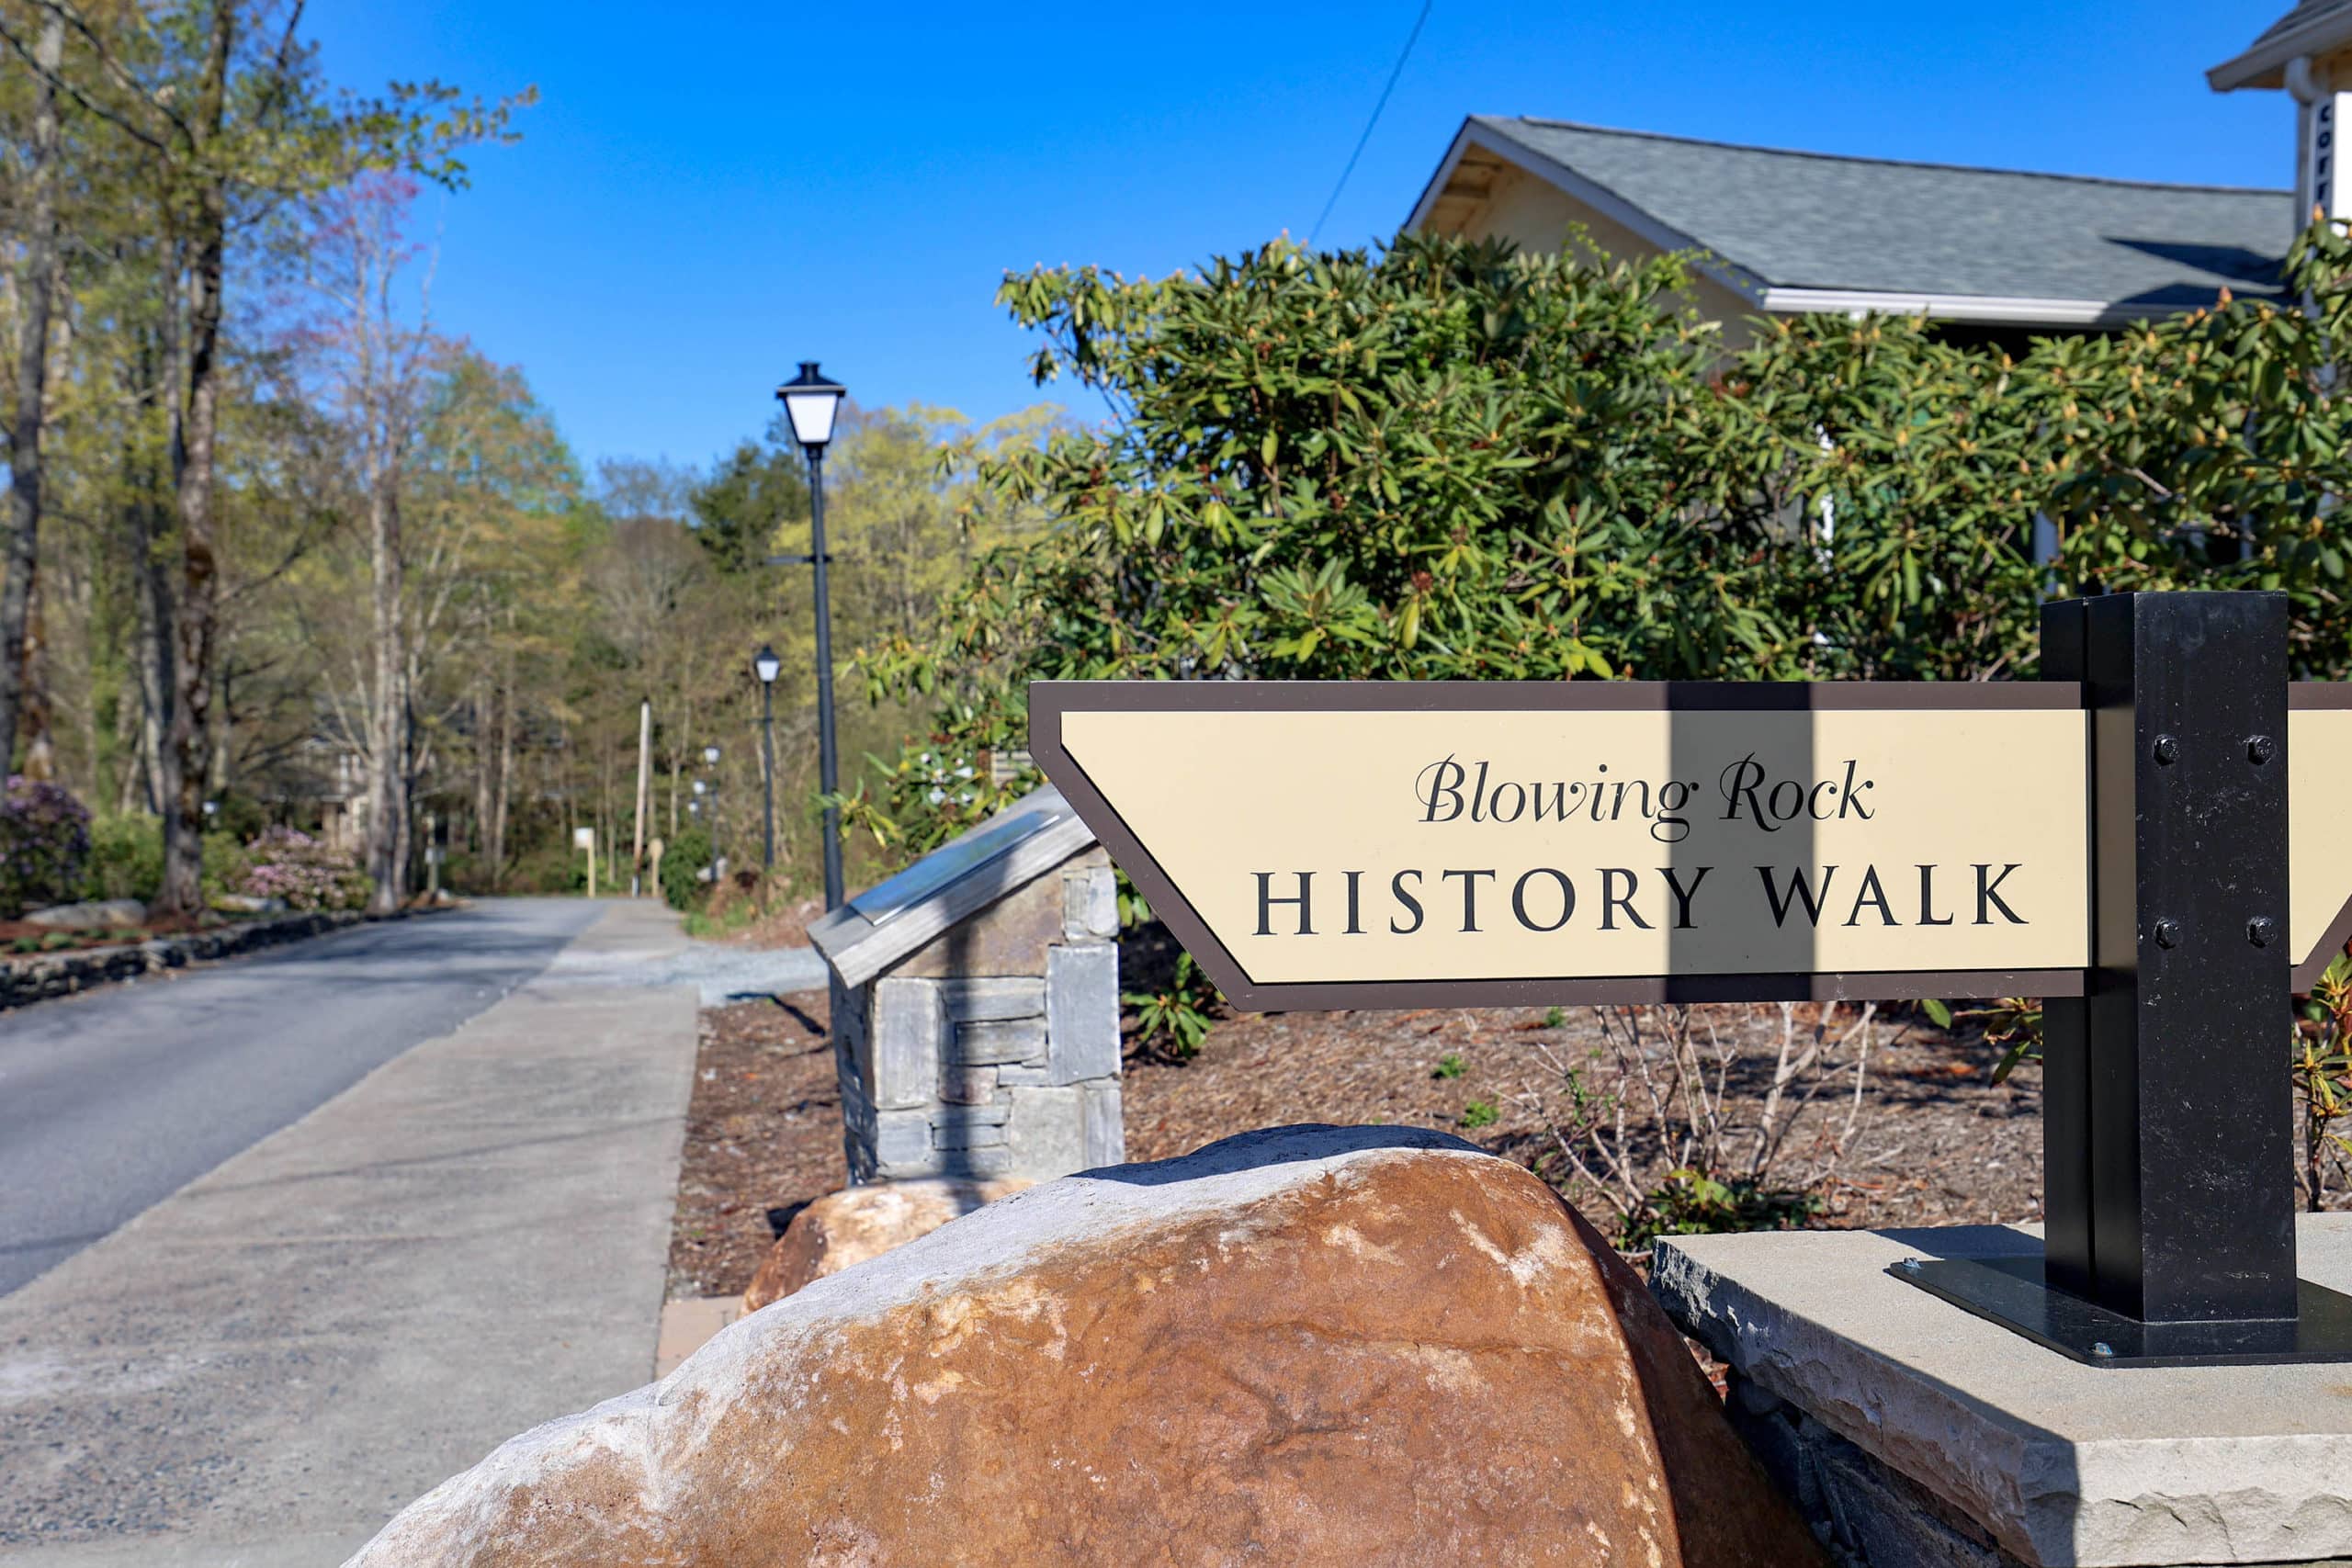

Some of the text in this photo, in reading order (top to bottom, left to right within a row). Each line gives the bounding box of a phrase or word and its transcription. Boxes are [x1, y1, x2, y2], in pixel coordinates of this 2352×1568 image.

[1416, 751, 1875, 842] Blowing Rock
[1250, 863, 2030, 936] HISTORY WALK
